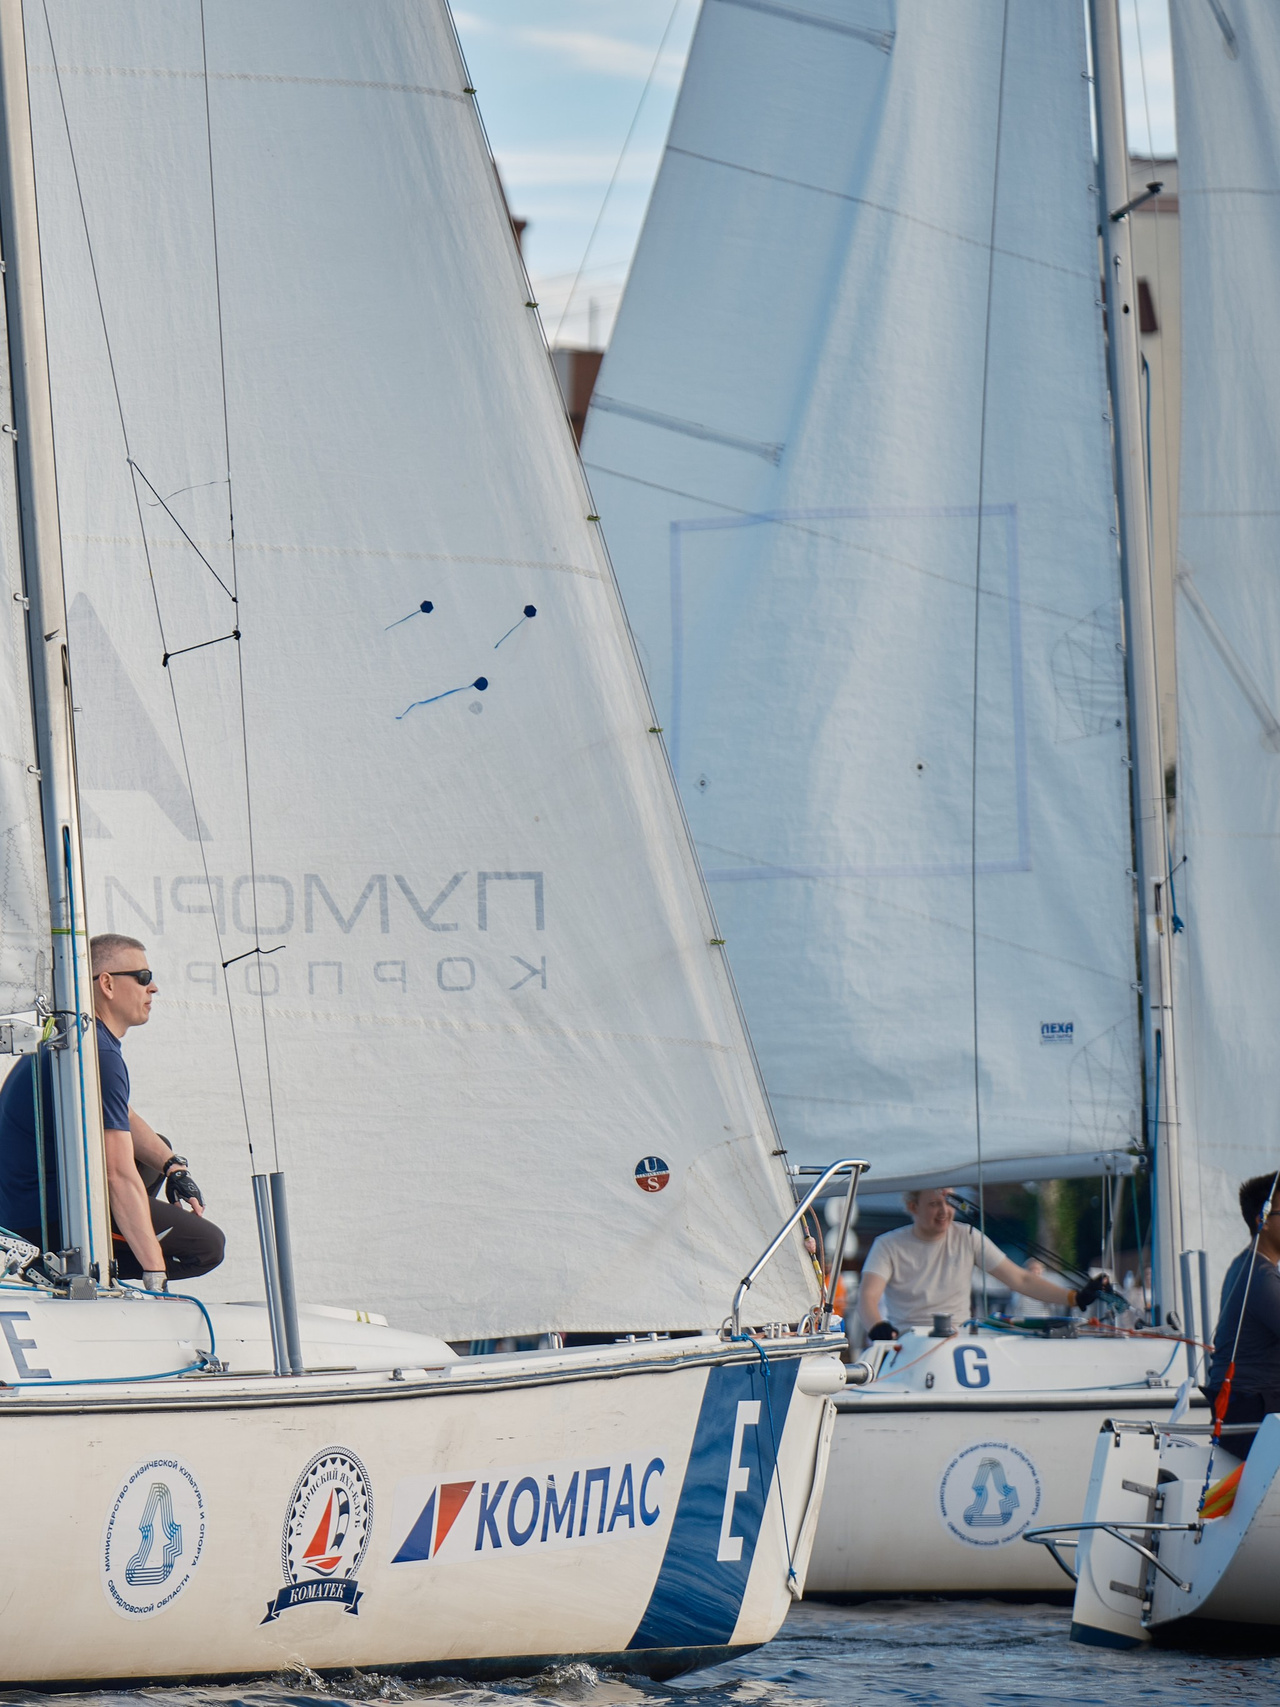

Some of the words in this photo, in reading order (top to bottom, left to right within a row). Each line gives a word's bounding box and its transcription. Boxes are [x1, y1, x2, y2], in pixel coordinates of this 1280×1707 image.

[953, 1344, 991, 1389] G
[129, 1459, 179, 1484] ФИЗИЧЕСКОЙ
[179, 1465, 204, 1509] КУЛЬТУРЫ
[716, 1400, 762, 1562] E
[199, 1511, 205, 1520] И
[295, 1467, 338, 1536] ГУБЕРНСКИЙ
[339, 1472, 362, 1529] ЯХТ-КЛУБ
[474, 1456, 666, 1552] КОМПАС
[105, 1485, 129, 1573] МИНИСТЕРСТВО
[191, 1523, 206, 1567] СПОРТА
[107, 1579, 155, 1614] СВЕРДЛОВСКОЙ
[156, 1574, 190, 1609] ОБЛАСТИ
[289, 1583, 347, 1604] КОМАТЕК
